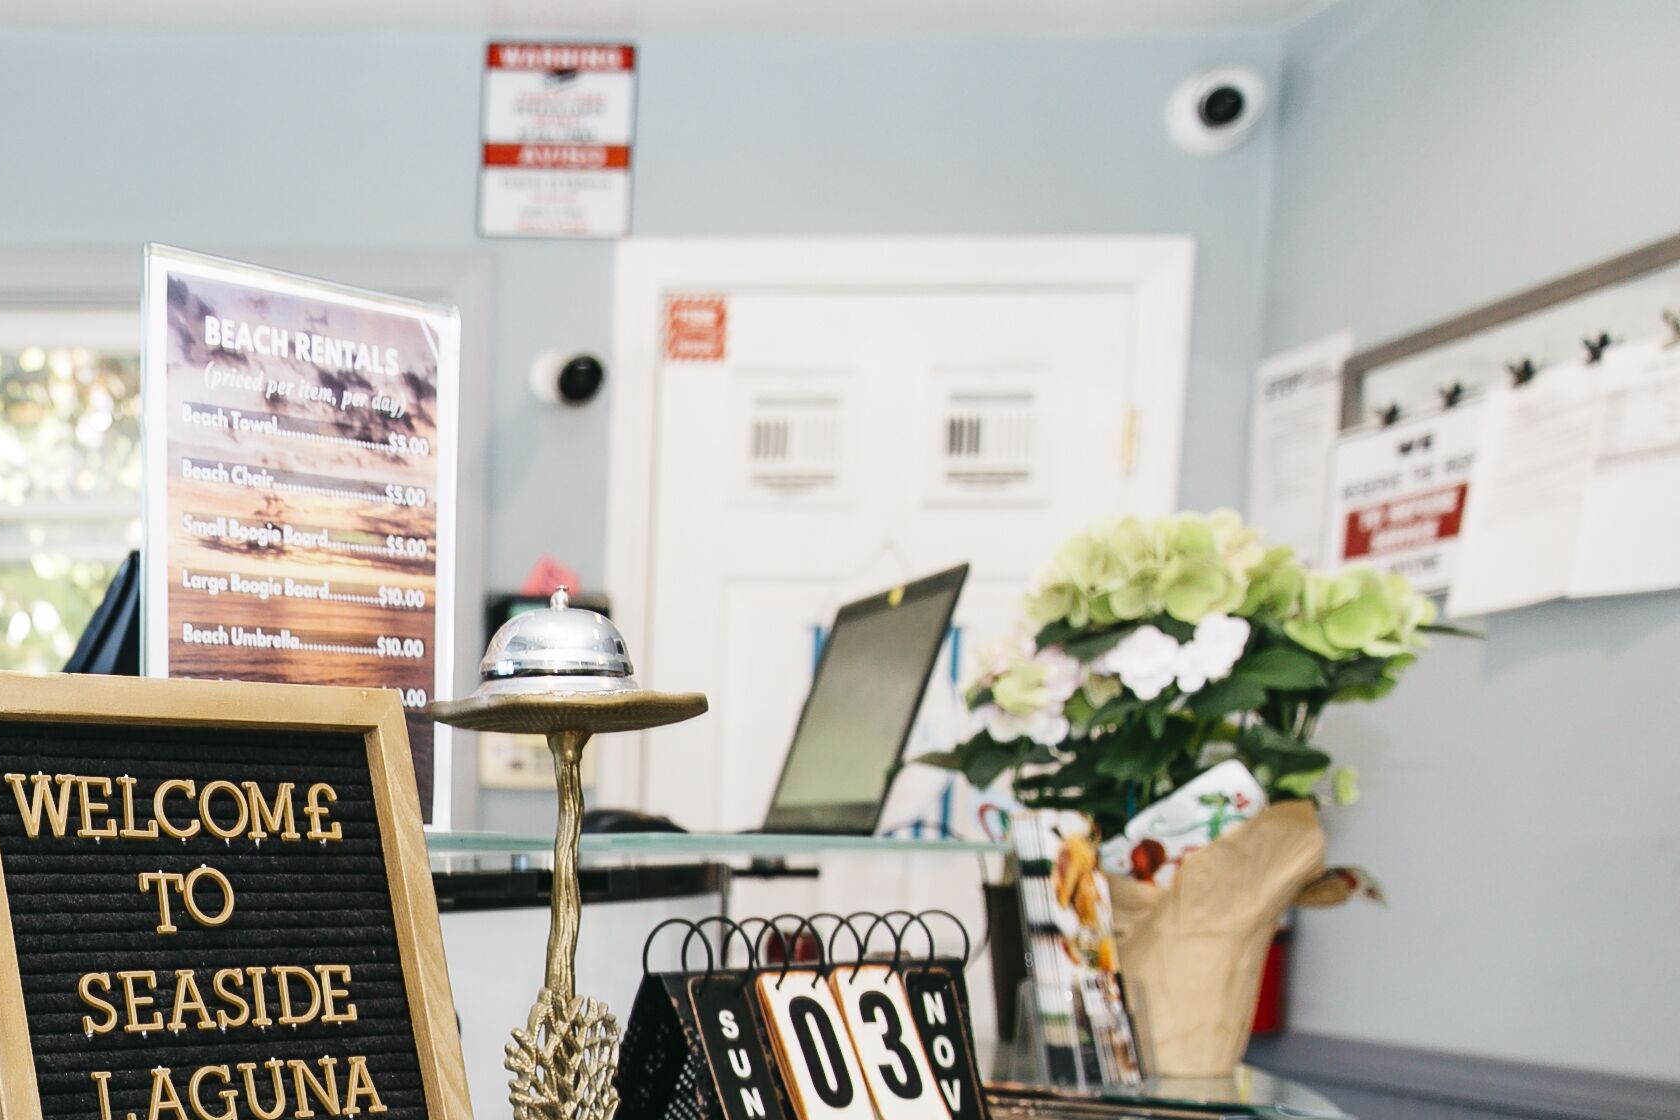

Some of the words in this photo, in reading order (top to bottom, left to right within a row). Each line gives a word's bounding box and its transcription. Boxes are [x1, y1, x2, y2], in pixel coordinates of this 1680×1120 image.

[204, 314, 289, 359] BEACH
[295, 331, 400, 377] RENTALS
[204, 360, 265, 394] (priced
[265, 379, 293, 400] per
[298, 378, 337, 406] item,
[341, 389, 370, 411] per
[371, 390, 407, 418] day)
[182, 402, 229, 428] Beach
[230, 407, 278, 435] Towel
[387, 430, 430, 457] $5.00
[182, 459, 229, 484] Beach
[231, 465, 275, 489] Chair
[384, 483, 427, 507] $5.00
[182, 513, 227, 537] Small
[229, 518, 282, 547] Boogie
[283, 524, 329, 548] Board
[385, 534, 427, 558] $5.00
[182, 568, 228, 596] Large
[230, 572, 282, 600] Boogie
[284, 576, 329, 600] Board
[378, 585, 425, 609] $10.00
[182, 622, 229, 646] Beach
[231, 625, 300, 651] Umbrella
[376, 634, 425, 658] $10.00
[138, 865, 235, 935] TO
[77, 964, 358, 1034] SEASIDE
[718, 1009, 766, 1119] SUN
[788, 990, 923, 1109] 03
[922, 991, 962, 1112] NOV
